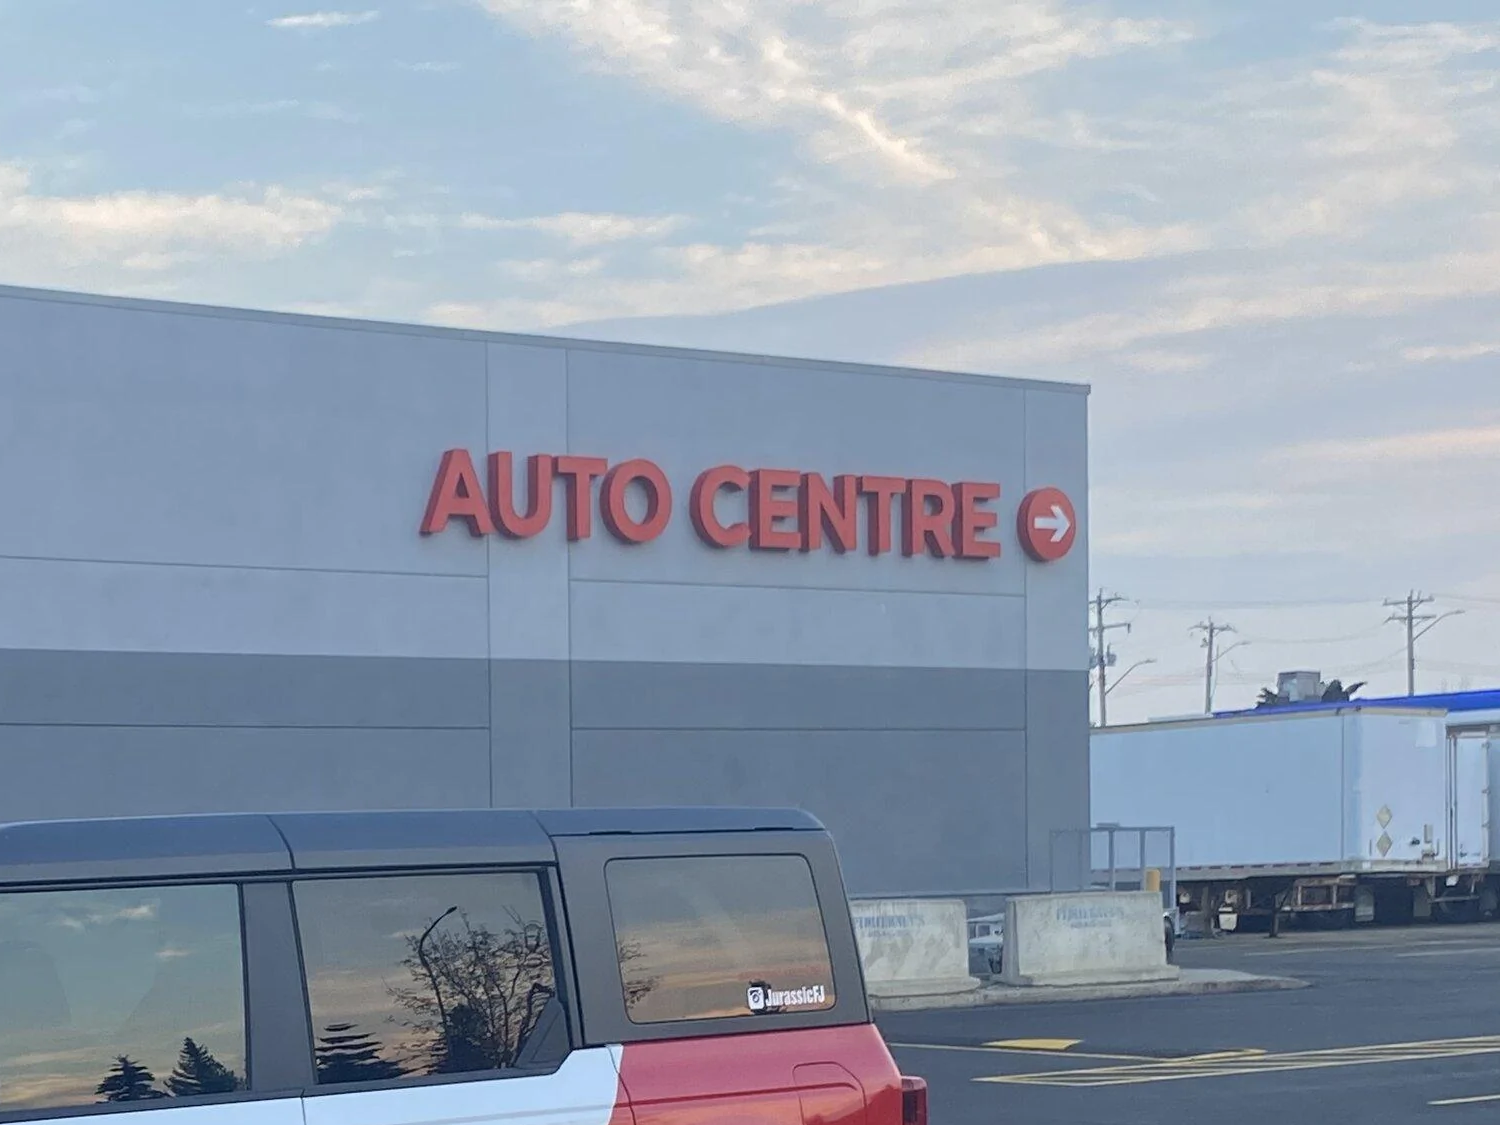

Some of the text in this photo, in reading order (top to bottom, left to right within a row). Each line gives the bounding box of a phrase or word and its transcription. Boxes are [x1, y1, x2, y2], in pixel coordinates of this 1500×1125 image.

[419, 448, 1000, 560] AUTO CENTRE
[765, 985, 826, 1007] JurassicFJ
